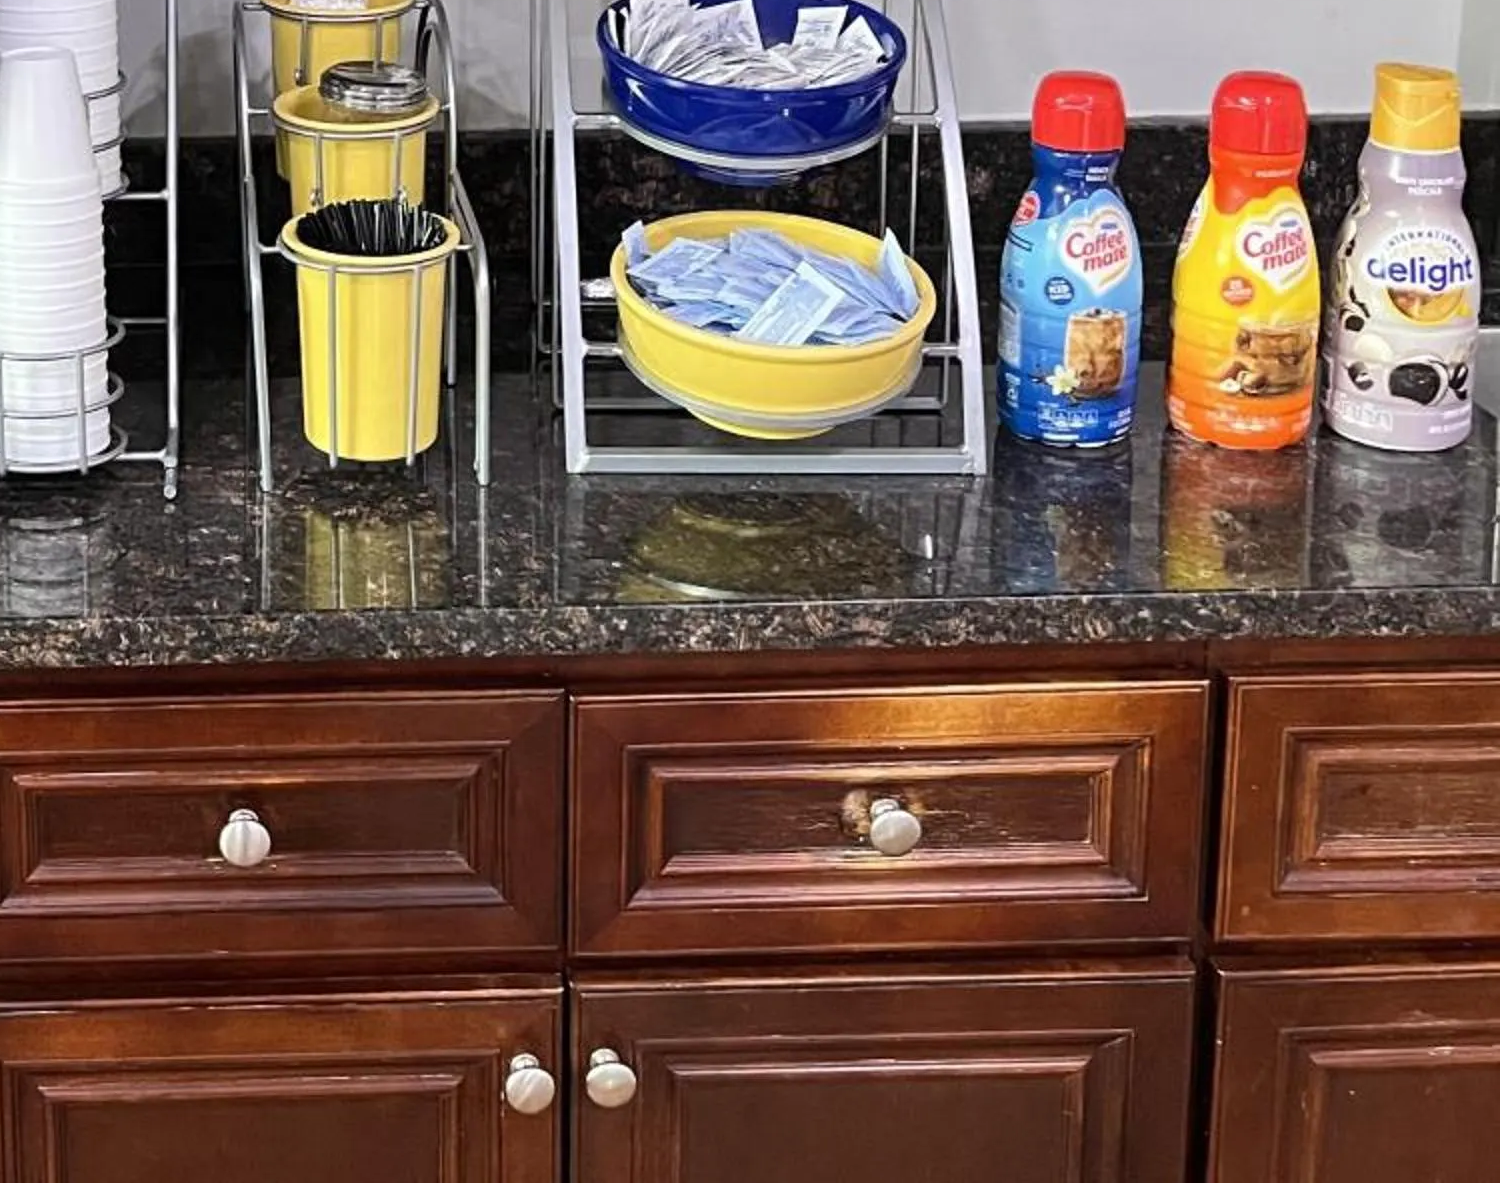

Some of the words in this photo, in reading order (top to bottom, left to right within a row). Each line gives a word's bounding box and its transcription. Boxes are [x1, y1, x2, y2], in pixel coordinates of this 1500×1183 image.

[1066, 229, 1125, 258] Coffee
[1243, 226, 1304, 258] Coffee
[1262, 240, 1308, 272] mate
[1083, 245, 1128, 273] mate
